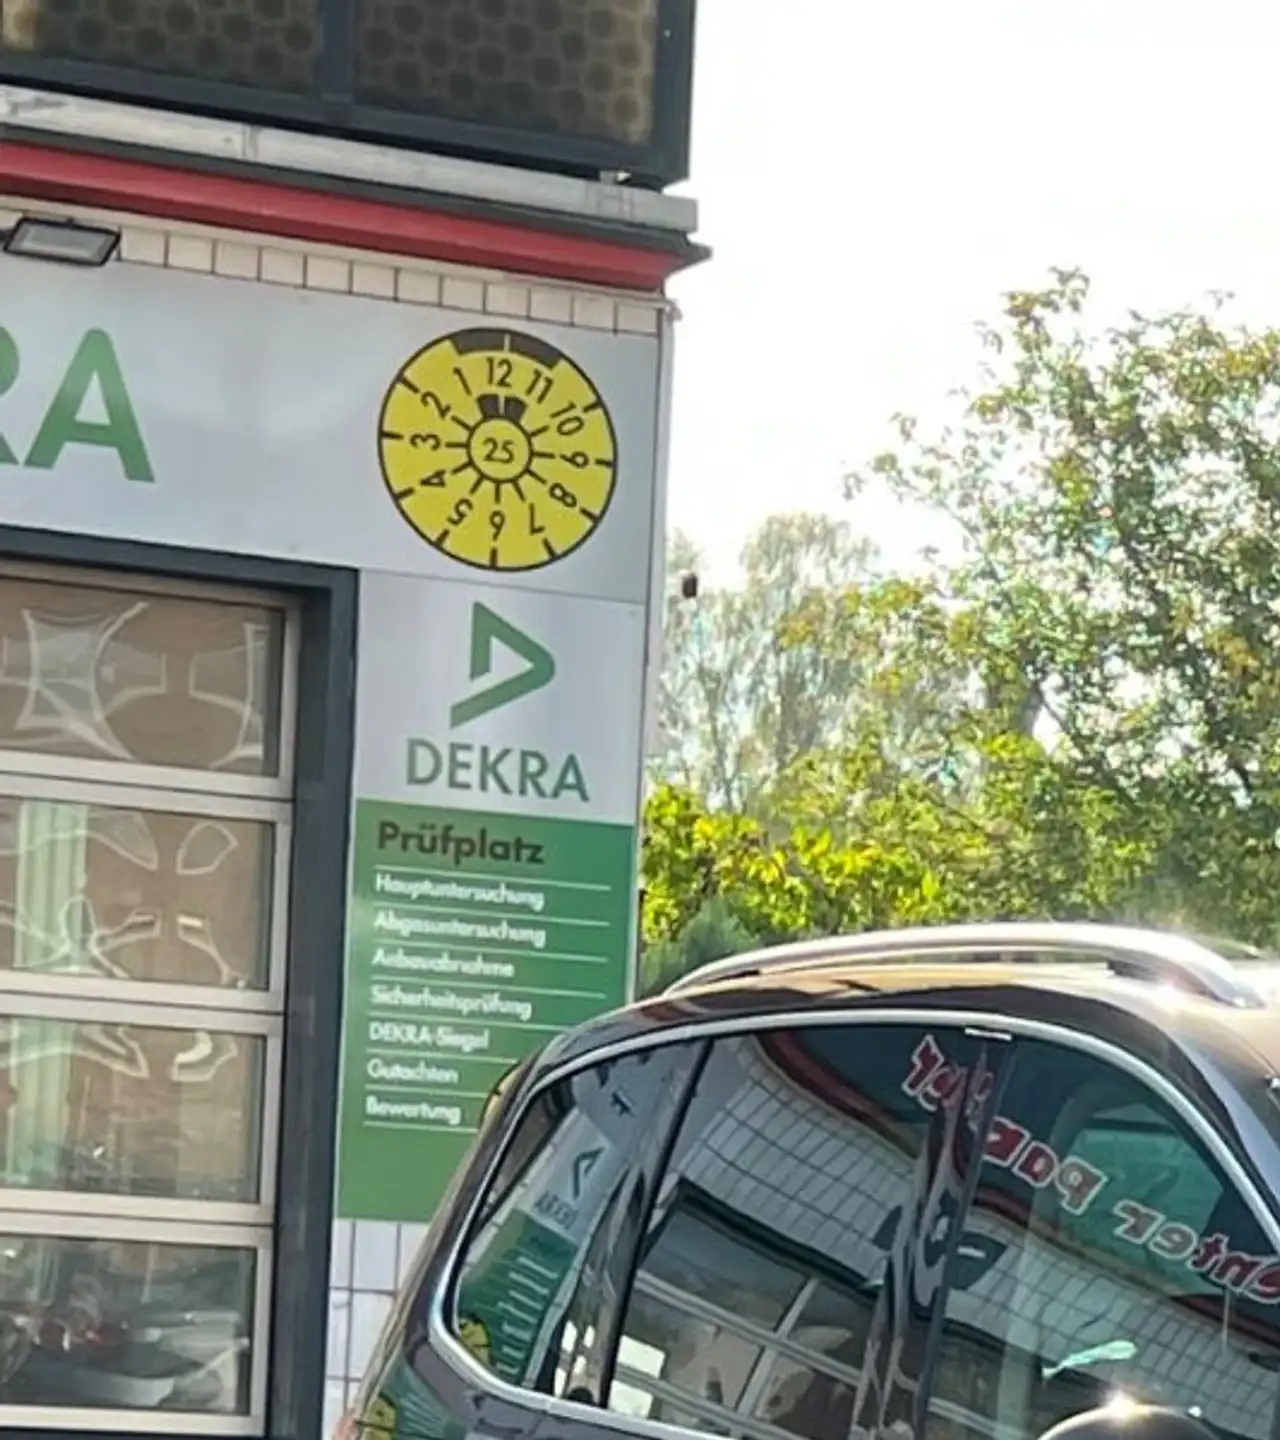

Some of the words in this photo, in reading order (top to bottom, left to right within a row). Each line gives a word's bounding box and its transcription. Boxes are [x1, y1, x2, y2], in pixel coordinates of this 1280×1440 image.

[453, 367, 472, 396] 1
[486, 357, 513, 388] 12
[525, 369, 554, 404] 11
[0, 326, 156, 483] A
[420, 391, 452, 418] 2
[550, 401, 584, 436] 10
[410, 434, 441, 450] 3
[482, 437, 515, 464] 25
[559, 451, 589, 468] 9
[420, 469, 446, 487] 4
[549, 482, 577, 509] 8
[448, 498, 474, 525] 5
[489, 511, 505, 541] 6
[528, 503, 546, 536] 7
[406, 738, 590, 802] DEKRA
[378, 820, 545, 865] Prüfplatz
[376, 872, 545, 912] Hauptuntersuchung
[367, 1058, 459, 1084] Gutachten
[365, 1095, 462, 1126] Bewertung
